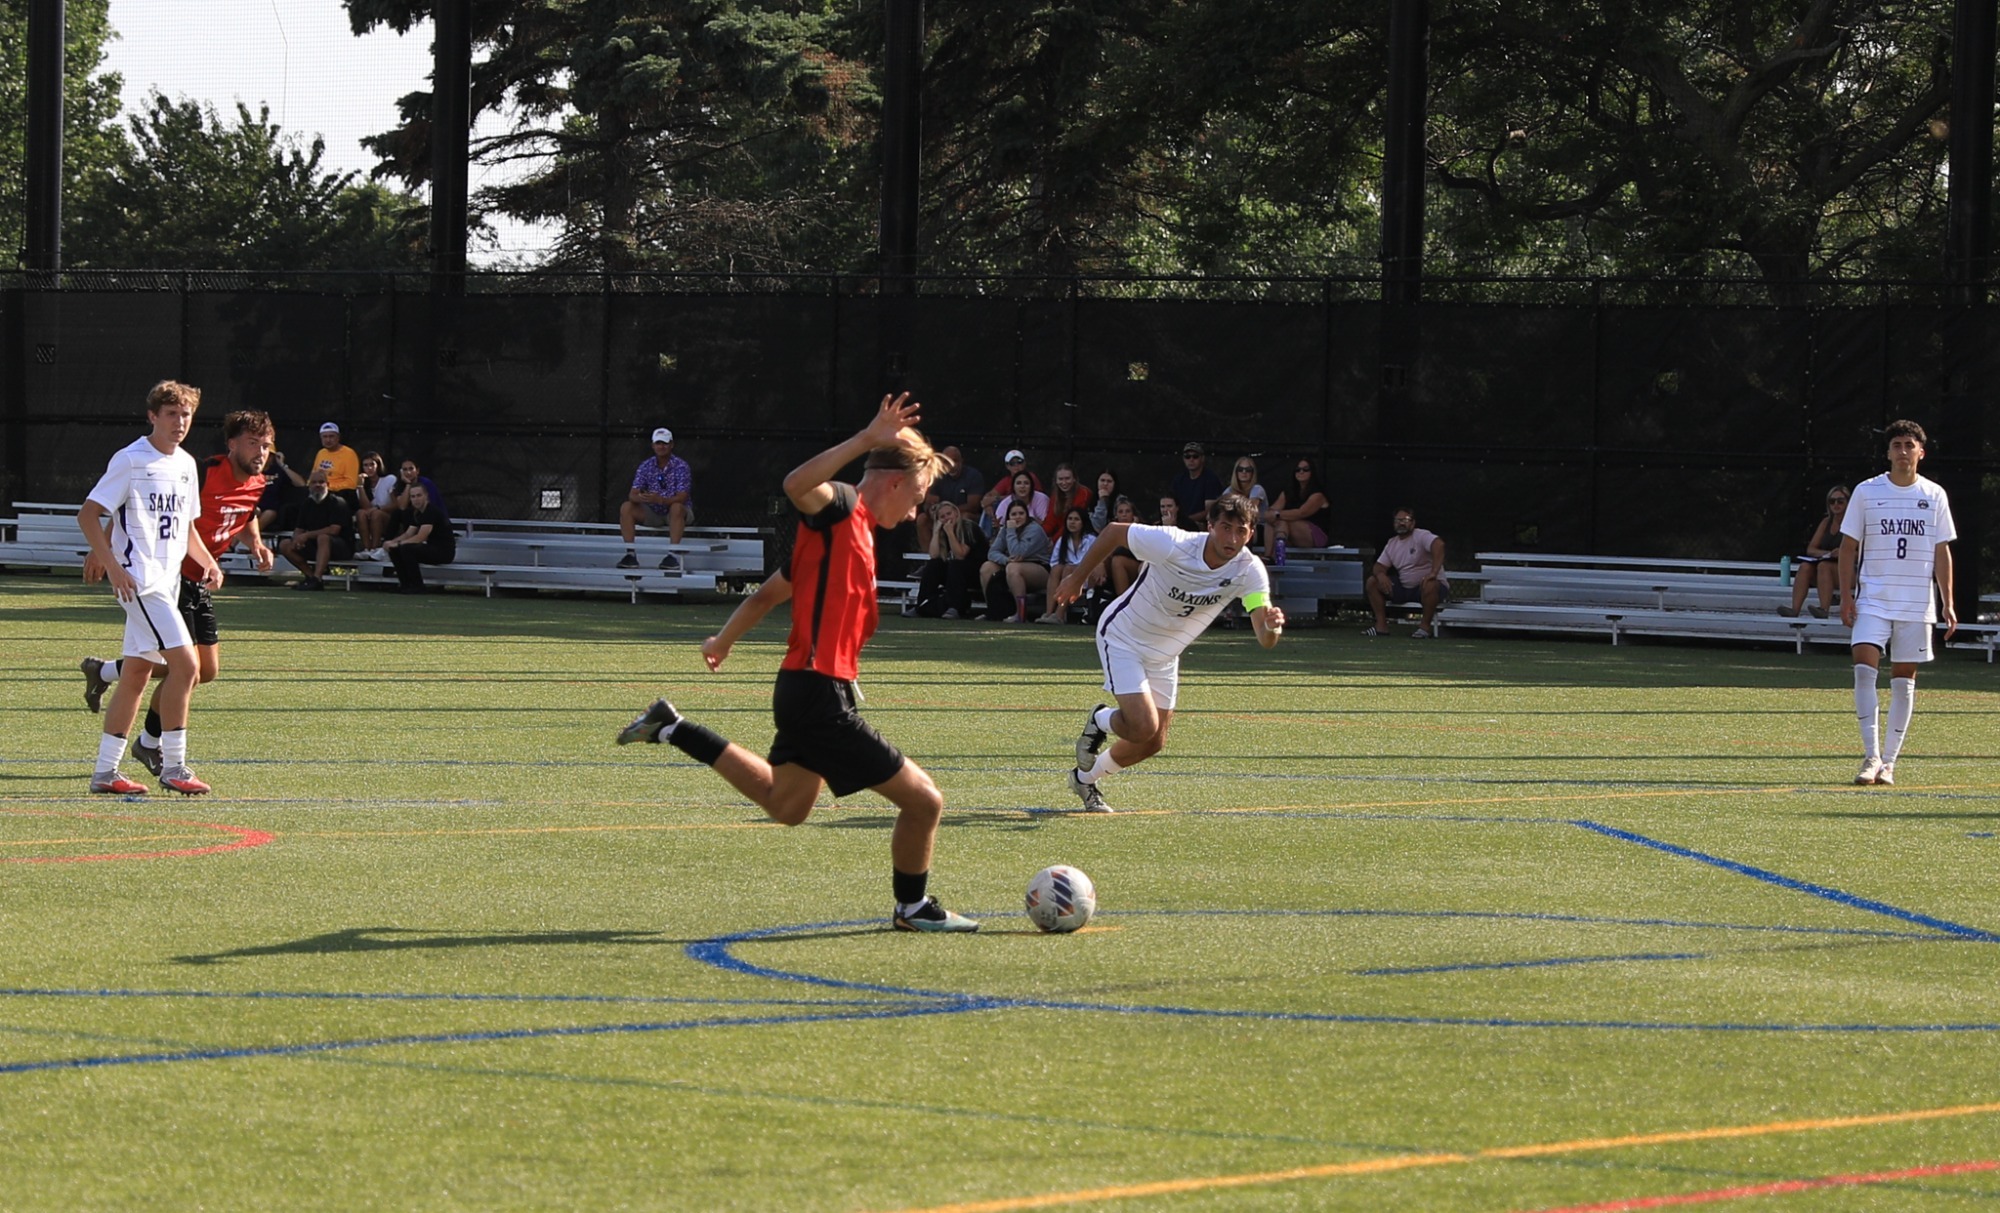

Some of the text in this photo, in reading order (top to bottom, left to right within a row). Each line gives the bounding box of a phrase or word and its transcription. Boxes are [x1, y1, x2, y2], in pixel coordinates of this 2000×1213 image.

[159, 515, 179, 540] 20
[1880, 518, 1925, 536] SAXONS
[1896, 537, 1907, 560] 8
[1168, 586, 1222, 606] SAXONS
[1177, 605, 1195, 618] 3
